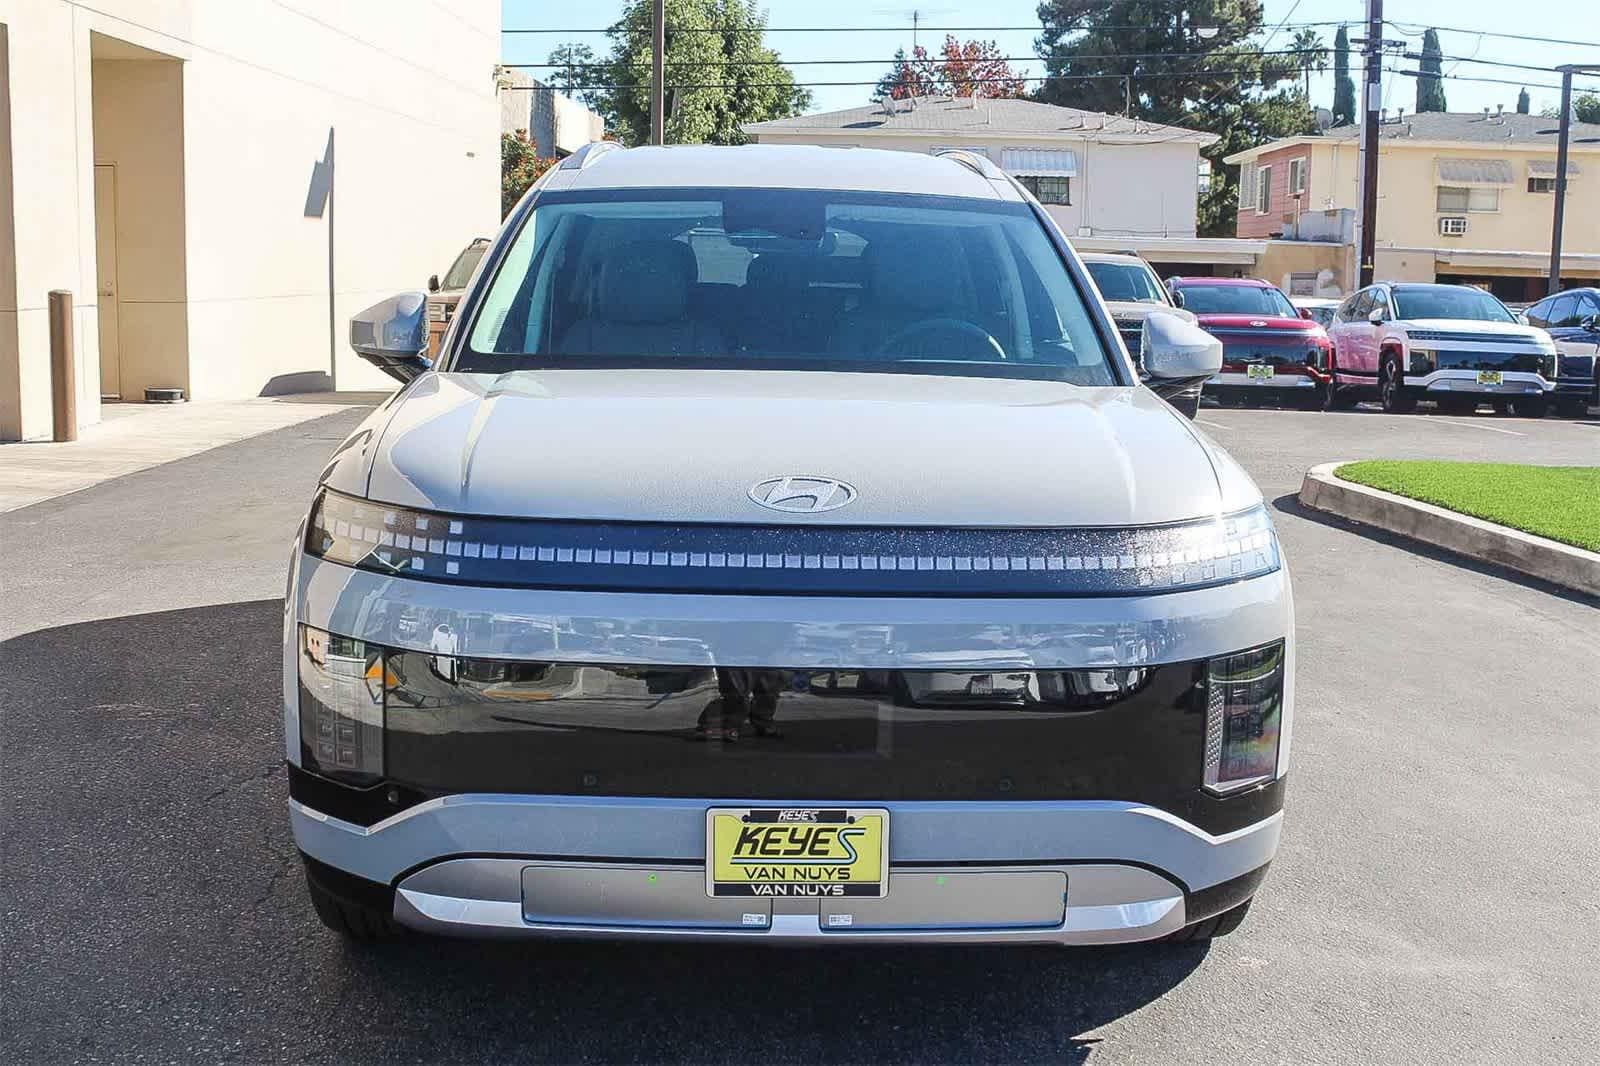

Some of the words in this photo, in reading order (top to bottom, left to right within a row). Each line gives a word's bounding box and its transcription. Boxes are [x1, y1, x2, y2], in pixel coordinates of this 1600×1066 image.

[778, 809, 819, 822] KEYES
[731, 827, 866, 865] KEYES
[743, 866, 786, 880] VAN
[793, 866, 850, 880] NUYS
[750, 884, 788, 896] VAN
[793, 884, 845, 896] NUYS
